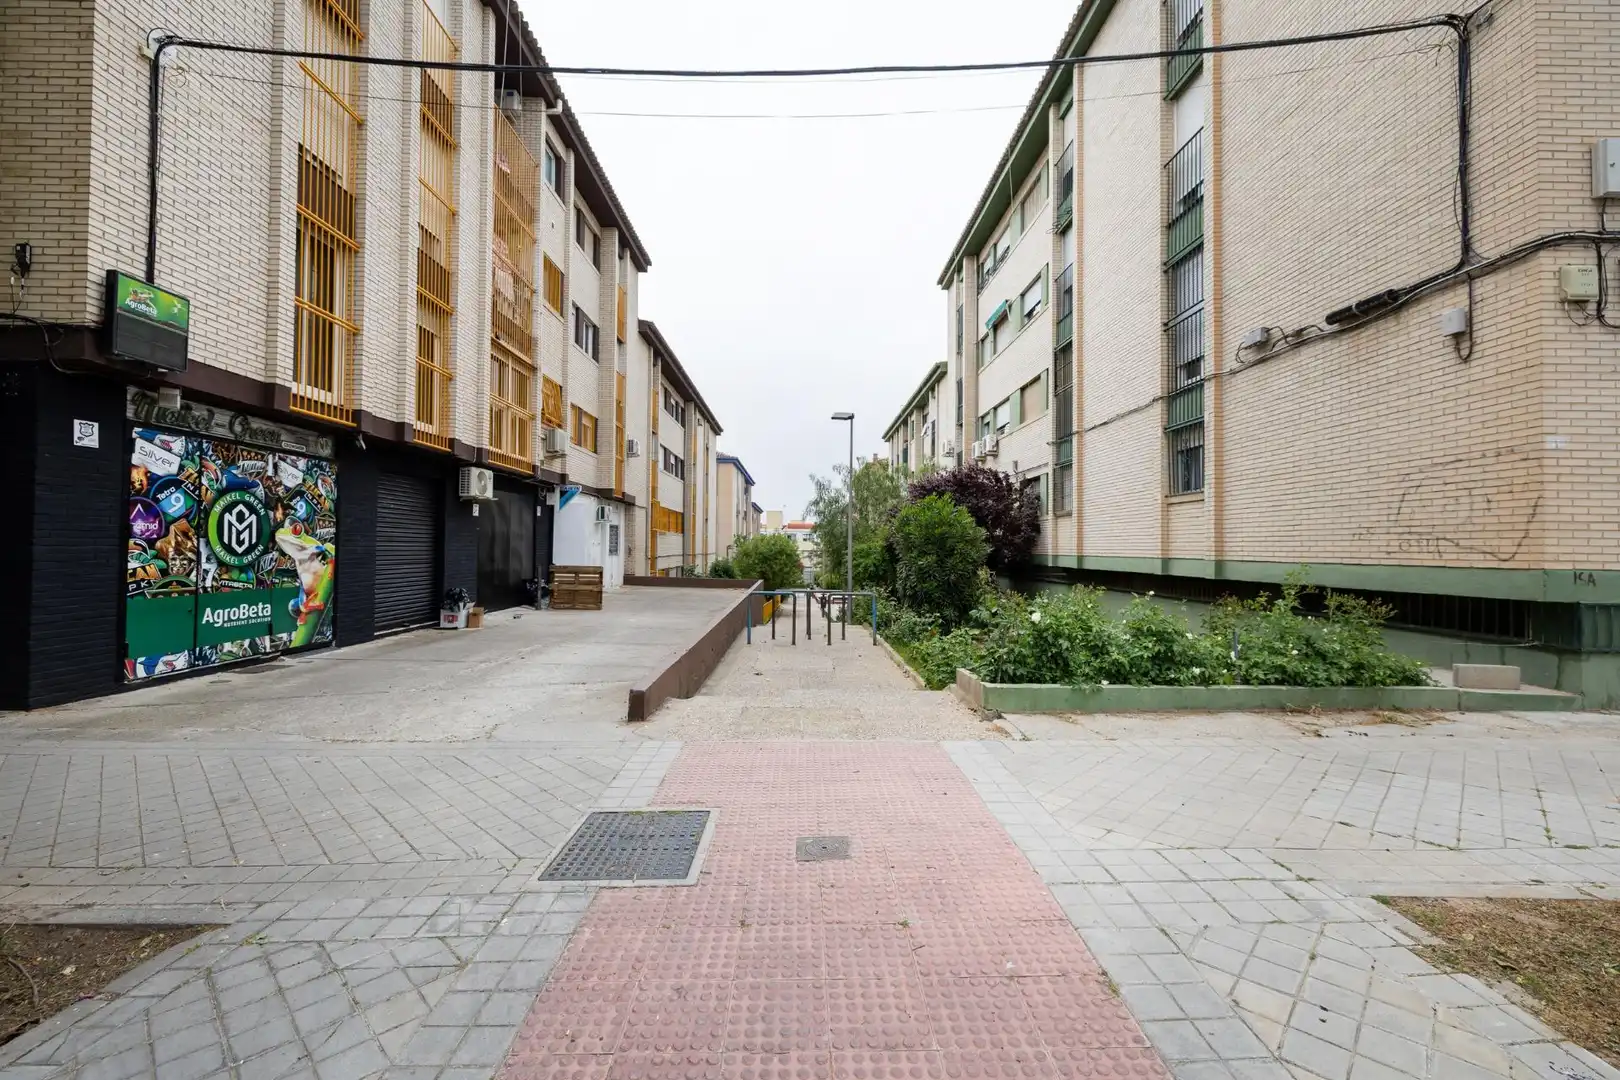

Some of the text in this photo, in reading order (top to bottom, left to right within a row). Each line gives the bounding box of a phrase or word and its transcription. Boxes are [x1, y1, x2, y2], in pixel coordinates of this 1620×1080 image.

[125, 297, 158, 315] AgroBeta
[139, 446, 174, 467] Silver
[156, 486, 176, 500] Tetra
[169, 493, 185, 514] 9
[214, 493, 266, 516] MAIKEL GREEN
[215, 545, 239, 565] MAIKEL
[242, 544, 264, 564] GREEN
[202, 602, 271, 627] AgroBeta
